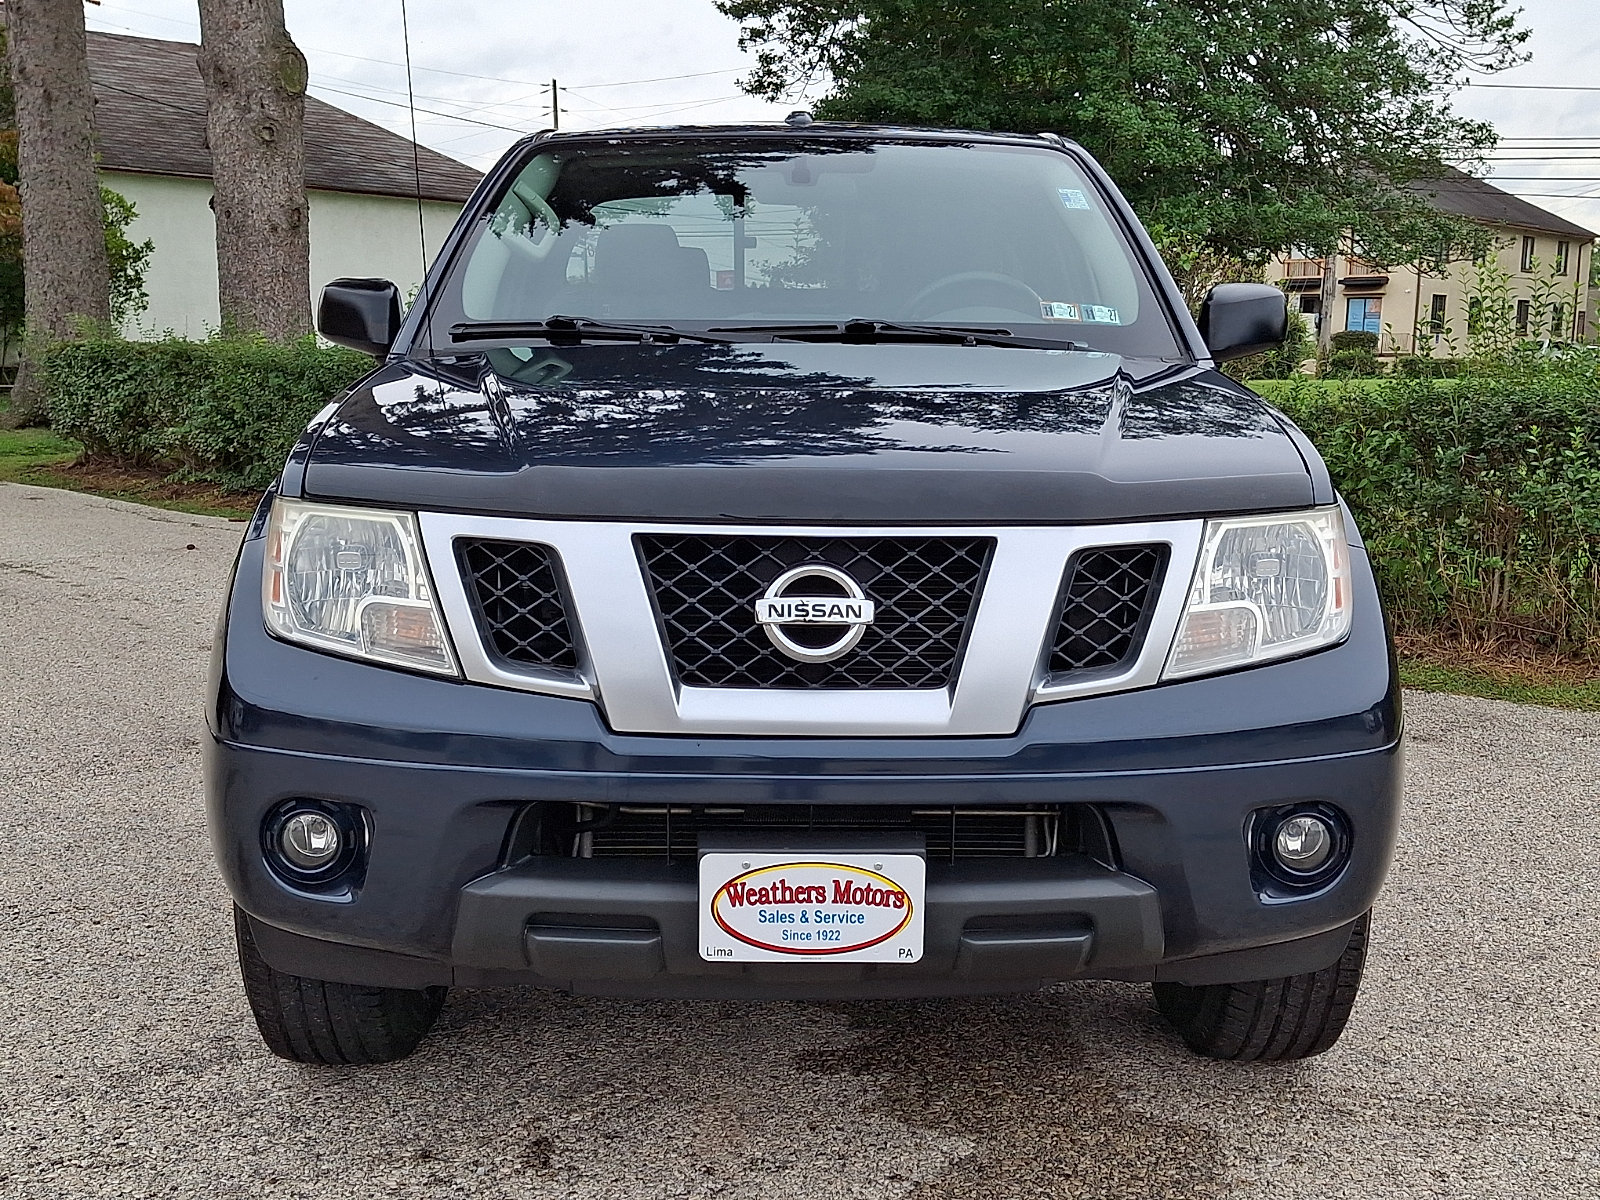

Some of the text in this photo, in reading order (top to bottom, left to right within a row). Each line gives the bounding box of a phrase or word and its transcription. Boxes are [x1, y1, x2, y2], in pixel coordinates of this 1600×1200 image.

[1067, 305, 1076, 318] 27
[1108, 309, 1117, 321] 27
[768, 603, 862, 618] NISSAN
[724, 879, 906, 909] Weathers Motors
[758, 910, 865, 925] Sales & Service
[782, 929, 841, 941] Since 1922
[706, 946, 733, 957] Lima
[898, 948, 913, 958] PA
